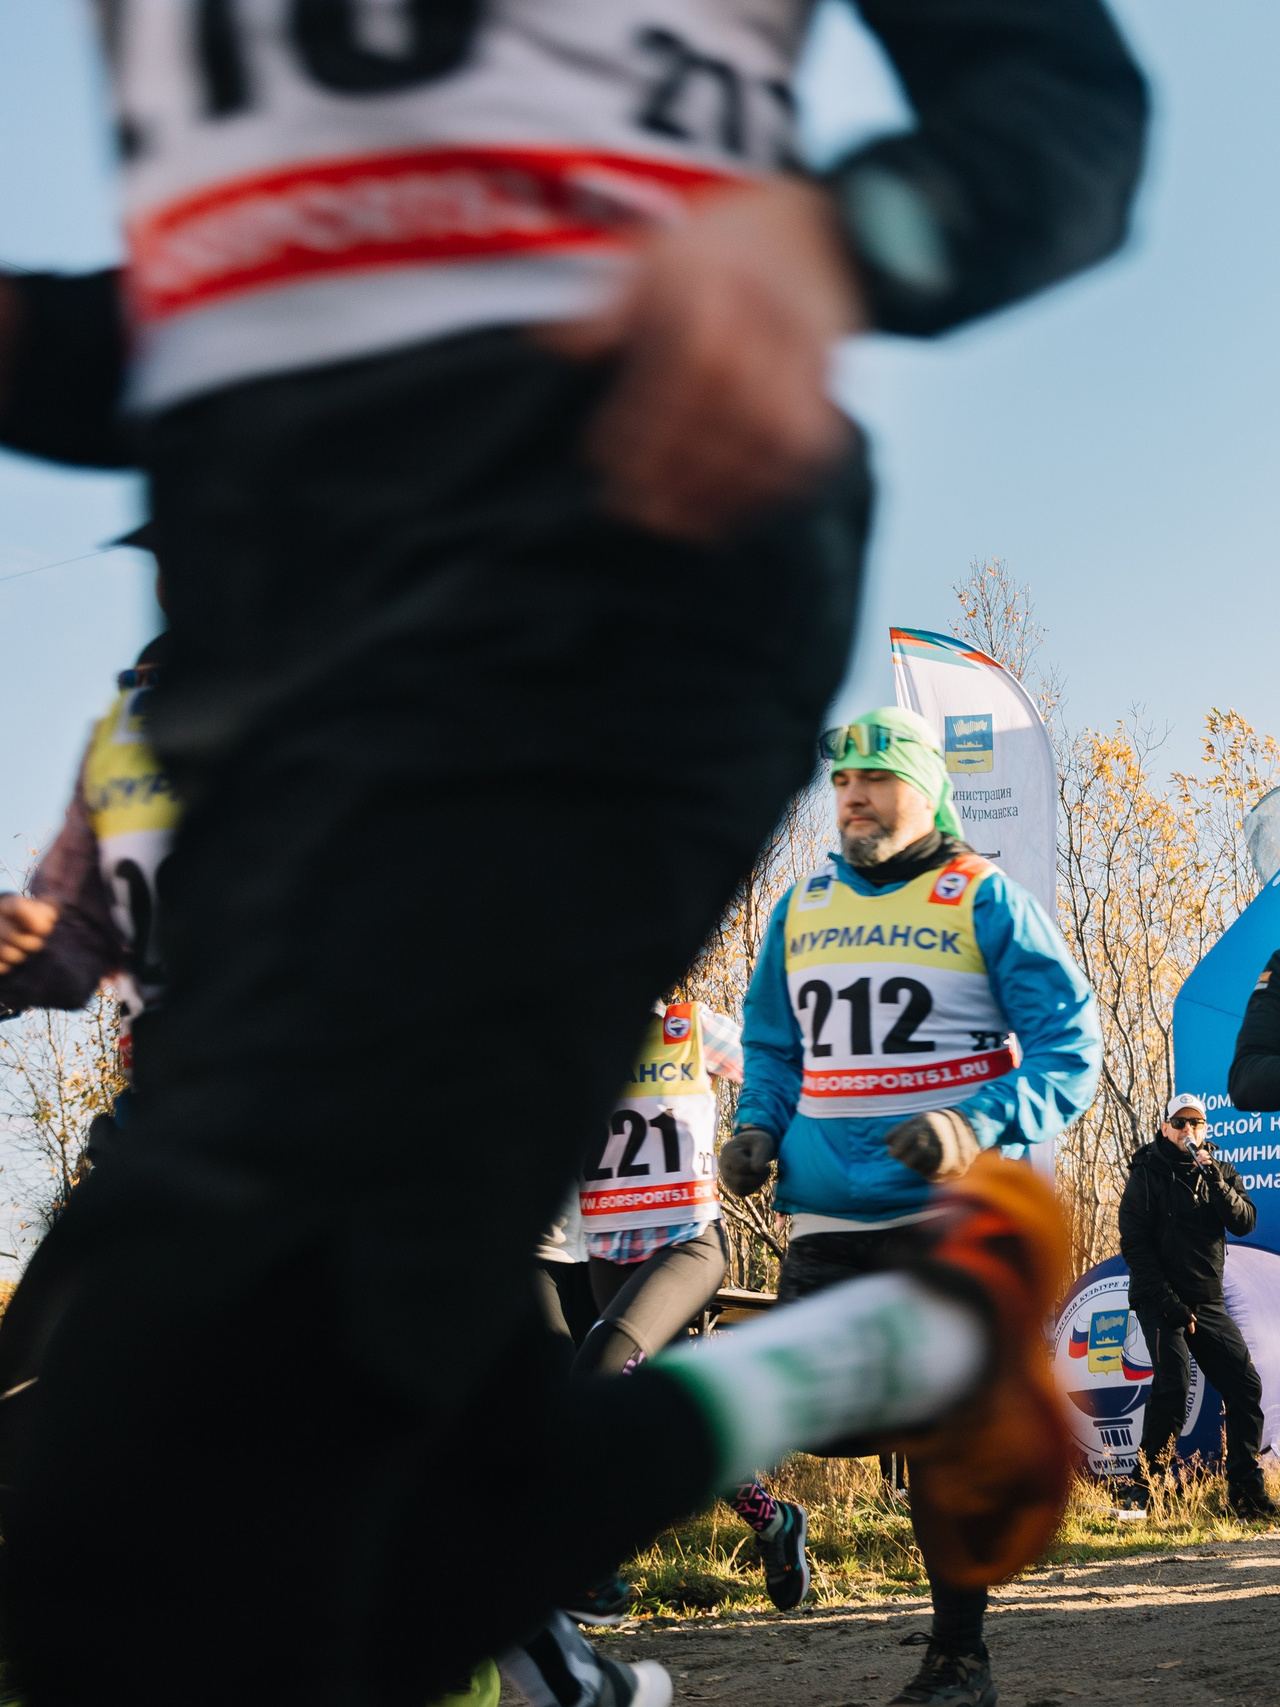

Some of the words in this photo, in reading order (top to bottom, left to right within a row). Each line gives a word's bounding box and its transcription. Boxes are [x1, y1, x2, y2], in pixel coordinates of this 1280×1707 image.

[961, 806, 1019, 822] Мурманска
[790, 925, 961, 959] МУРМАНСК
[798, 976, 936, 1058] 212
